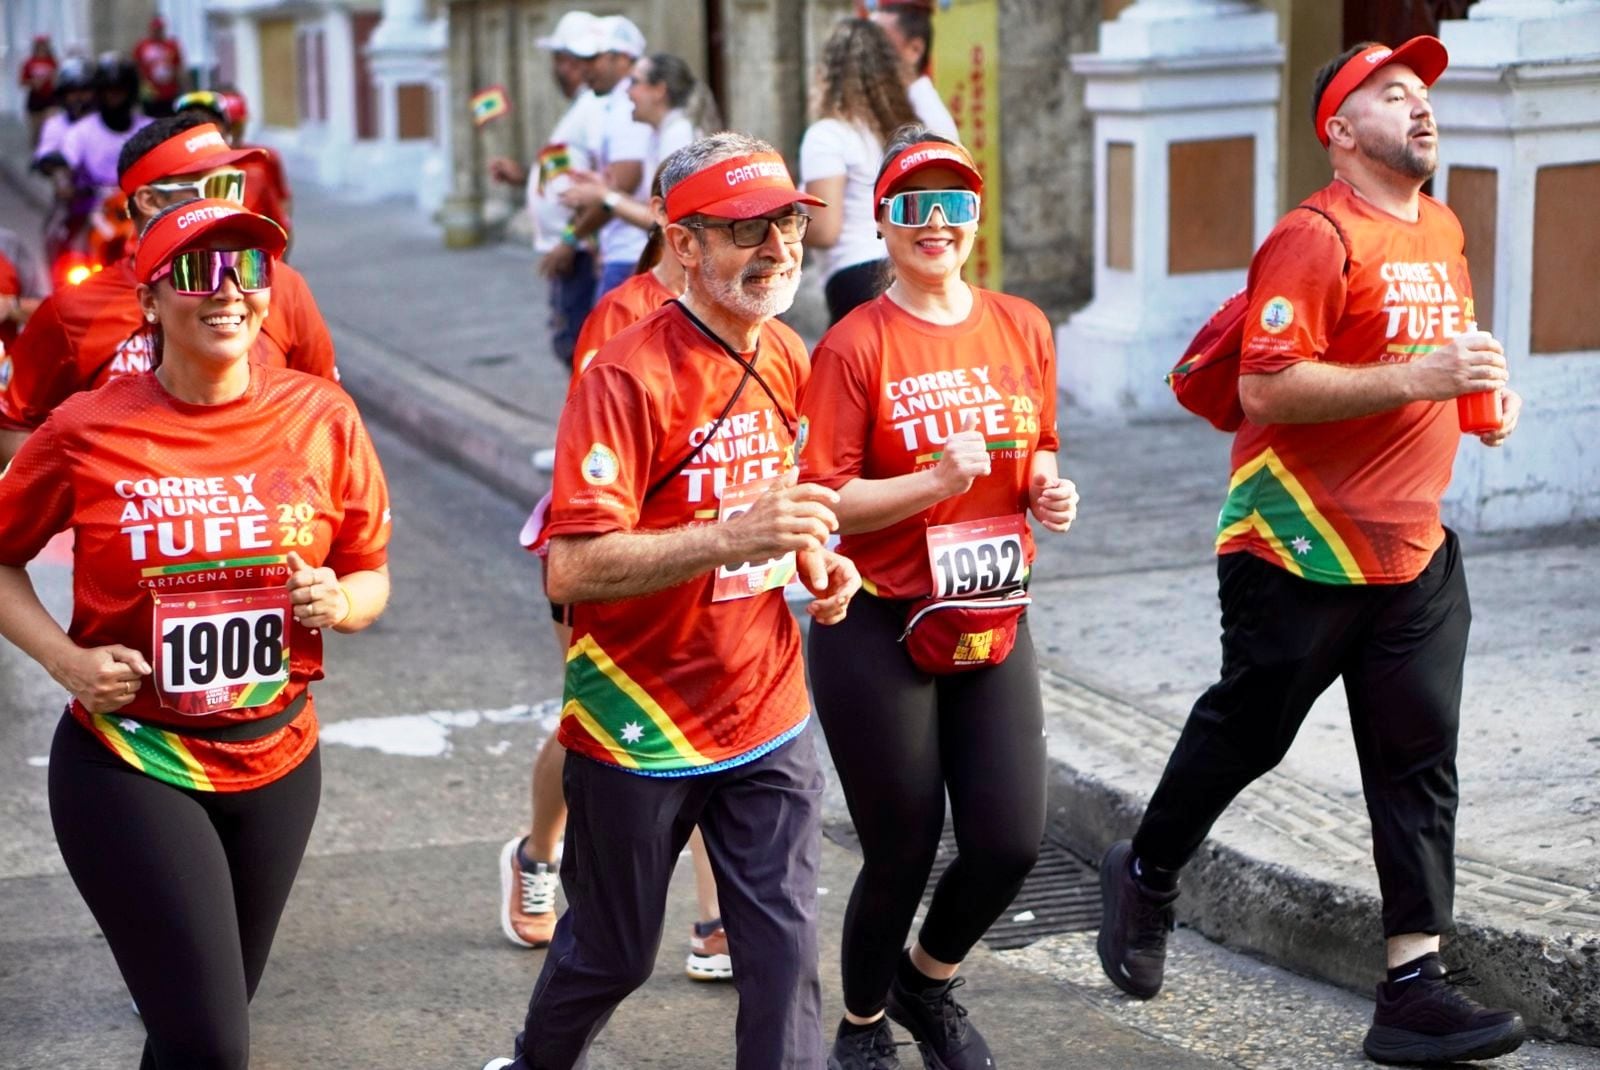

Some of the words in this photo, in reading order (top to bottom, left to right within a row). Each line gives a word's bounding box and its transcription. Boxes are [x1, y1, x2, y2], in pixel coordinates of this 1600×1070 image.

[1432, 261, 1449, 281] Y
[886, 369, 971, 400] CORRE
[971, 365, 990, 384] Y
[892, 384, 1002, 420] ANUNCIA
[1009, 395, 1034, 414] 20
[689, 410, 760, 448] CORRE
[764, 408, 775, 430] Y
[1014, 415, 1037, 433] 26
[115, 477, 228, 498] CORRE
[233, 473, 257, 494] Y
[119, 494, 266, 523] ANUNCIA
[276, 503, 315, 523] 20
[279, 525, 314, 547] 26
[138, 569, 228, 589] CARTAGENA
[235, 568, 253, 578] DE
[260, 565, 292, 577] INDI
[936, 540, 1020, 597] 1932
[163, 614, 283, 686] 1908
